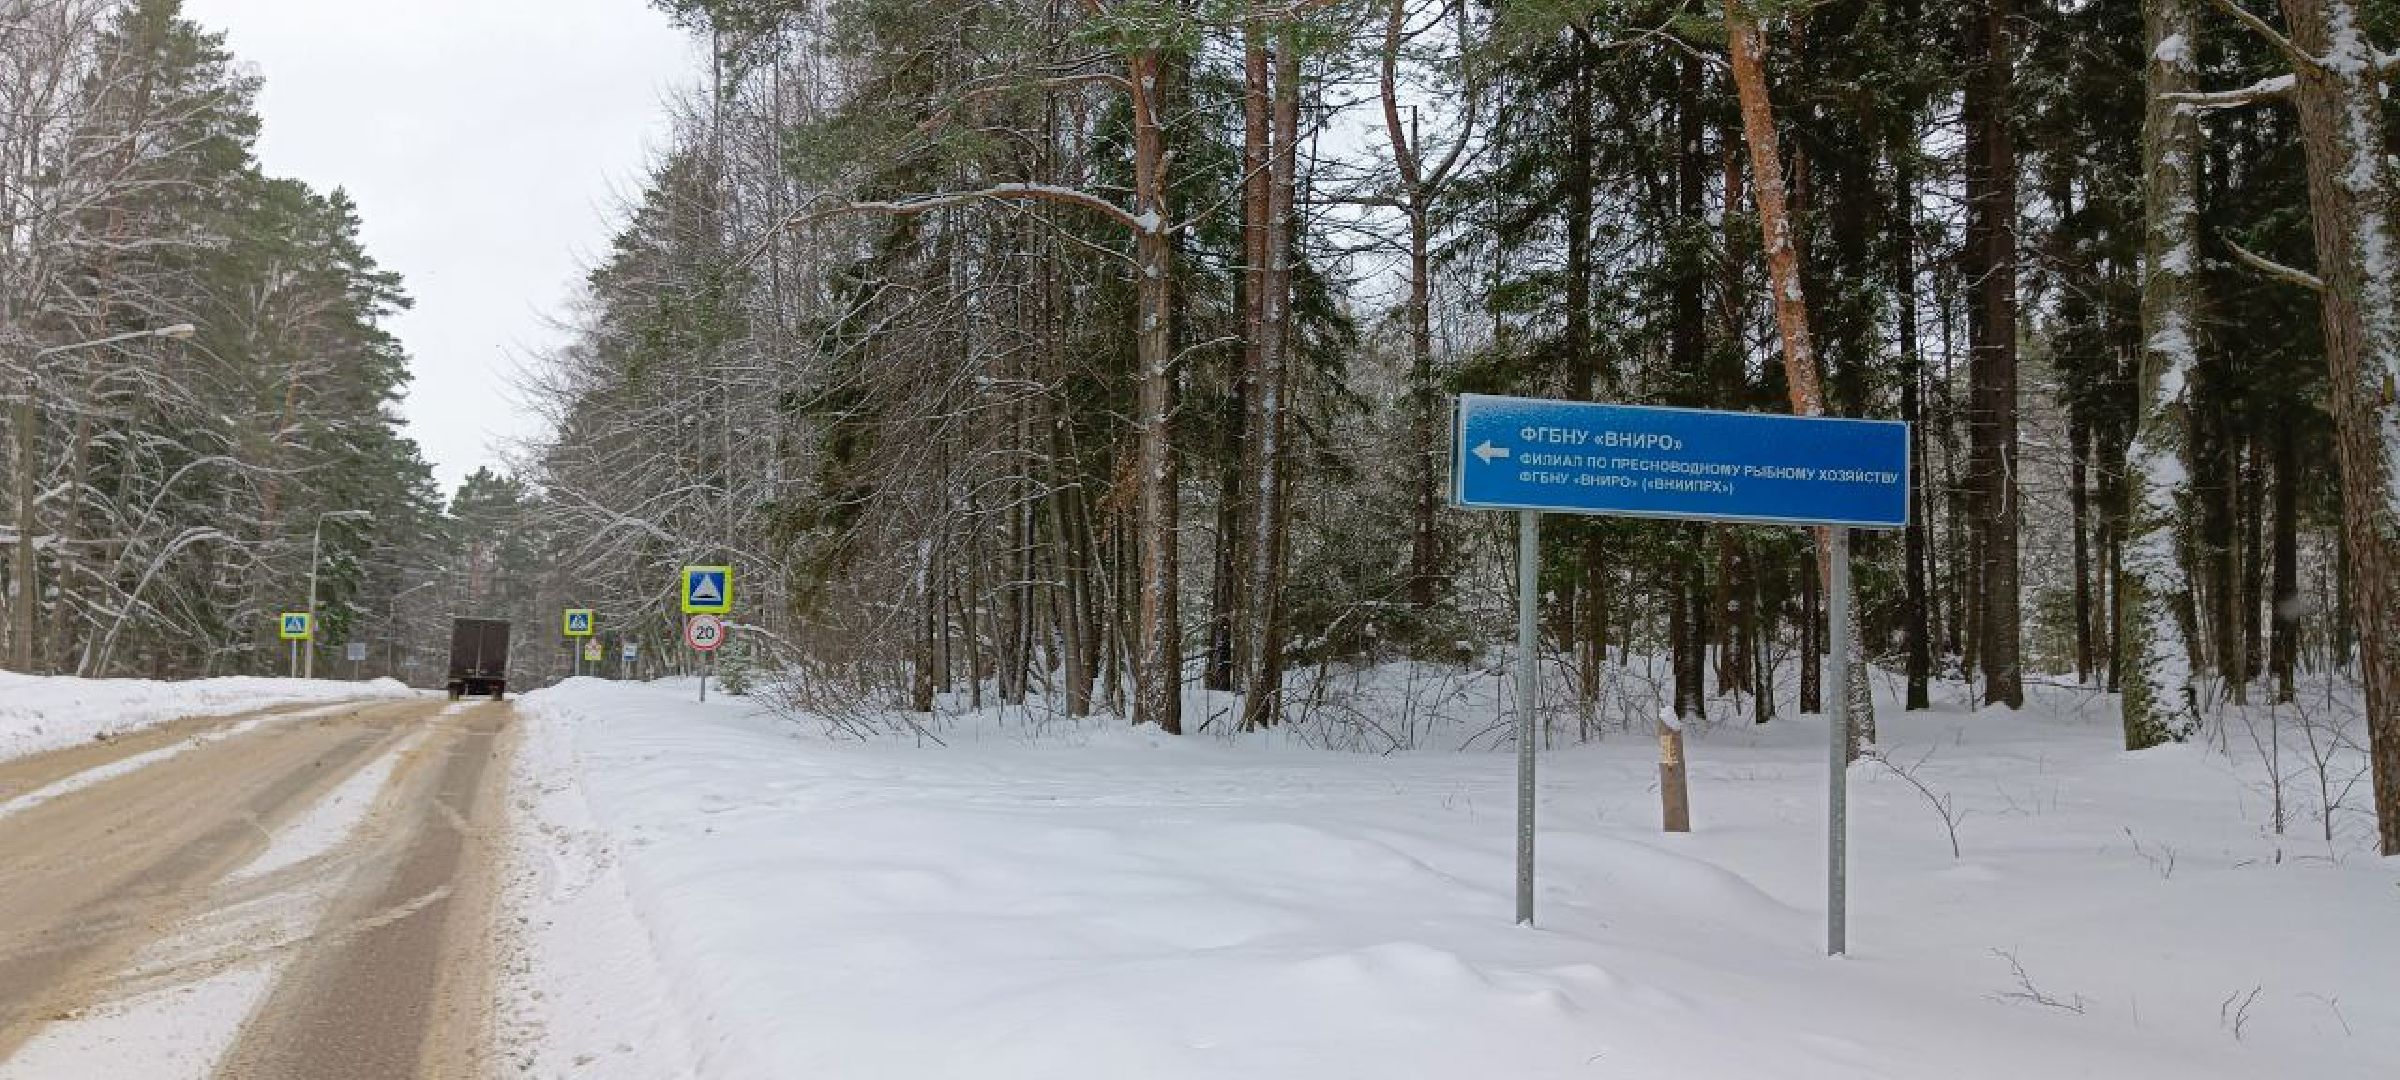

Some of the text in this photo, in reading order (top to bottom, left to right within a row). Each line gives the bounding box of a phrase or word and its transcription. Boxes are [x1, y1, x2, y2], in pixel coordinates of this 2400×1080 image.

[1520, 426, 1682, 451] ФГБНУ «ВНИРО»
[1519, 452, 1899, 484] ФИЛИАЛ ПО ПРЕСНОВОДНОМУ РЫБНОМУ ХОЗЯЙСТВУ
[1519, 471, 1733, 496] ФГБНУ «ВНИРО» («ВНИИПРХ»)
[697, 625, 715, 640] 20
